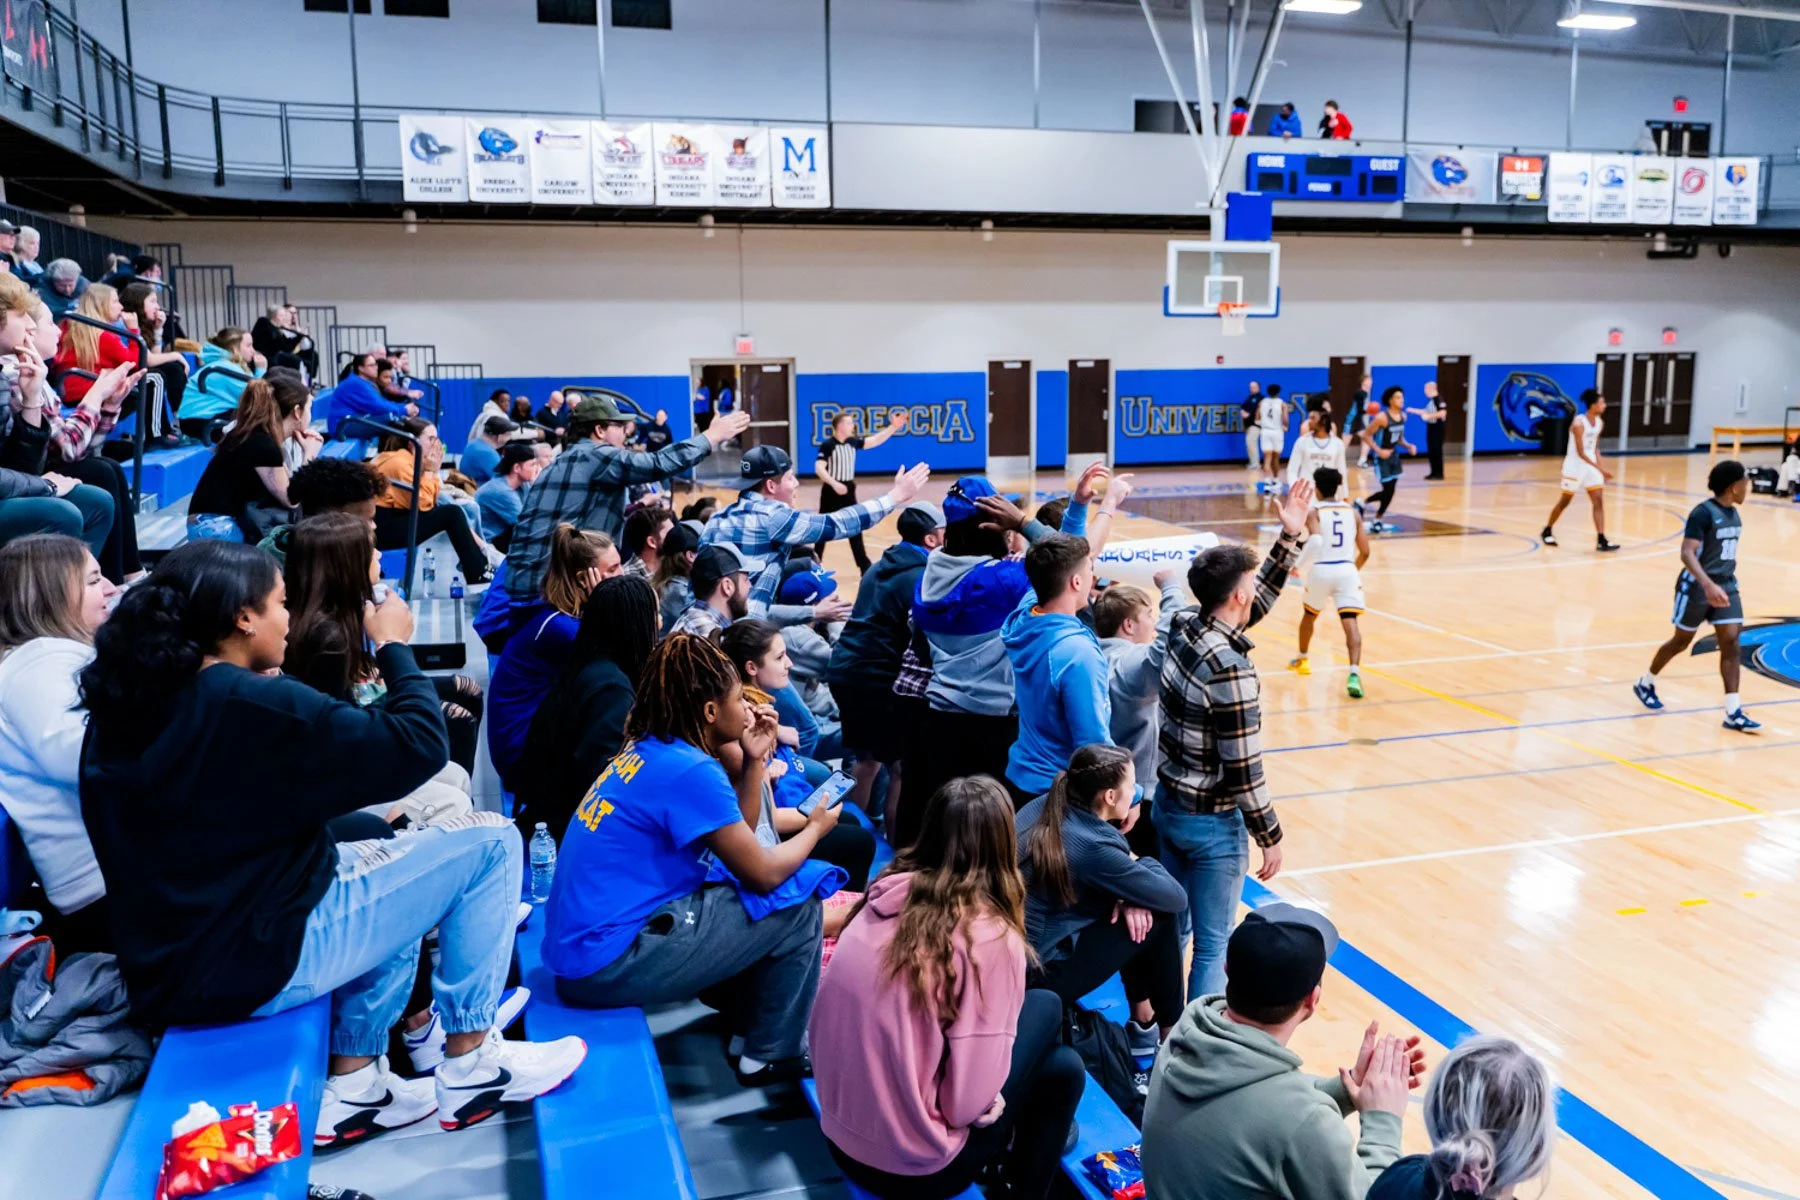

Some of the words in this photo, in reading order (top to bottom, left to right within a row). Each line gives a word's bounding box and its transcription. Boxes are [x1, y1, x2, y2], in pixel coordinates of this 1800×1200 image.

[1257, 155, 1286, 168] HOME
[1369, 158, 1400, 171] GUEST
[1331, 520, 1344, 548] 5
